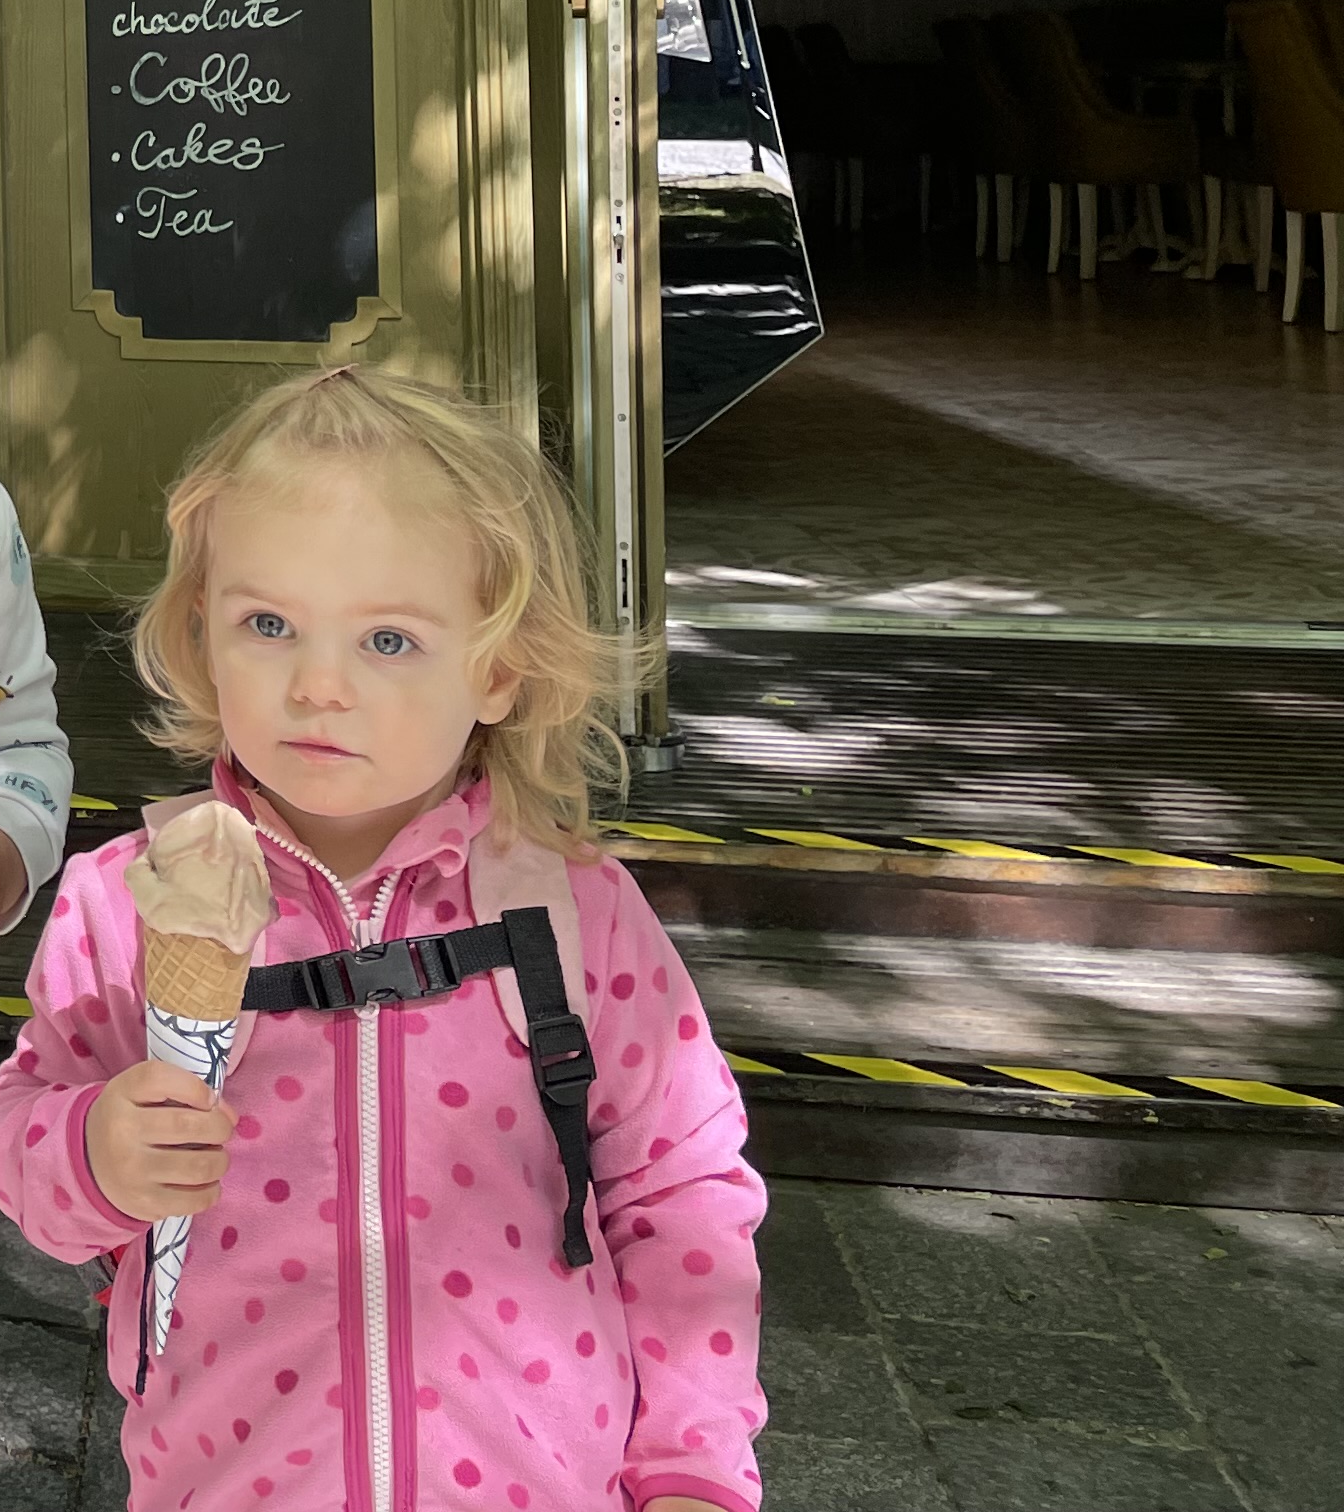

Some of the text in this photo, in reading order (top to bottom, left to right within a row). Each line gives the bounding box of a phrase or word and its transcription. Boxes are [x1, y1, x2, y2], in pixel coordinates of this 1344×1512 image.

[129, 51, 291, 115] Coffee
[129, 122, 285, 172] Cakes
[136, 186, 234, 240] Tea
